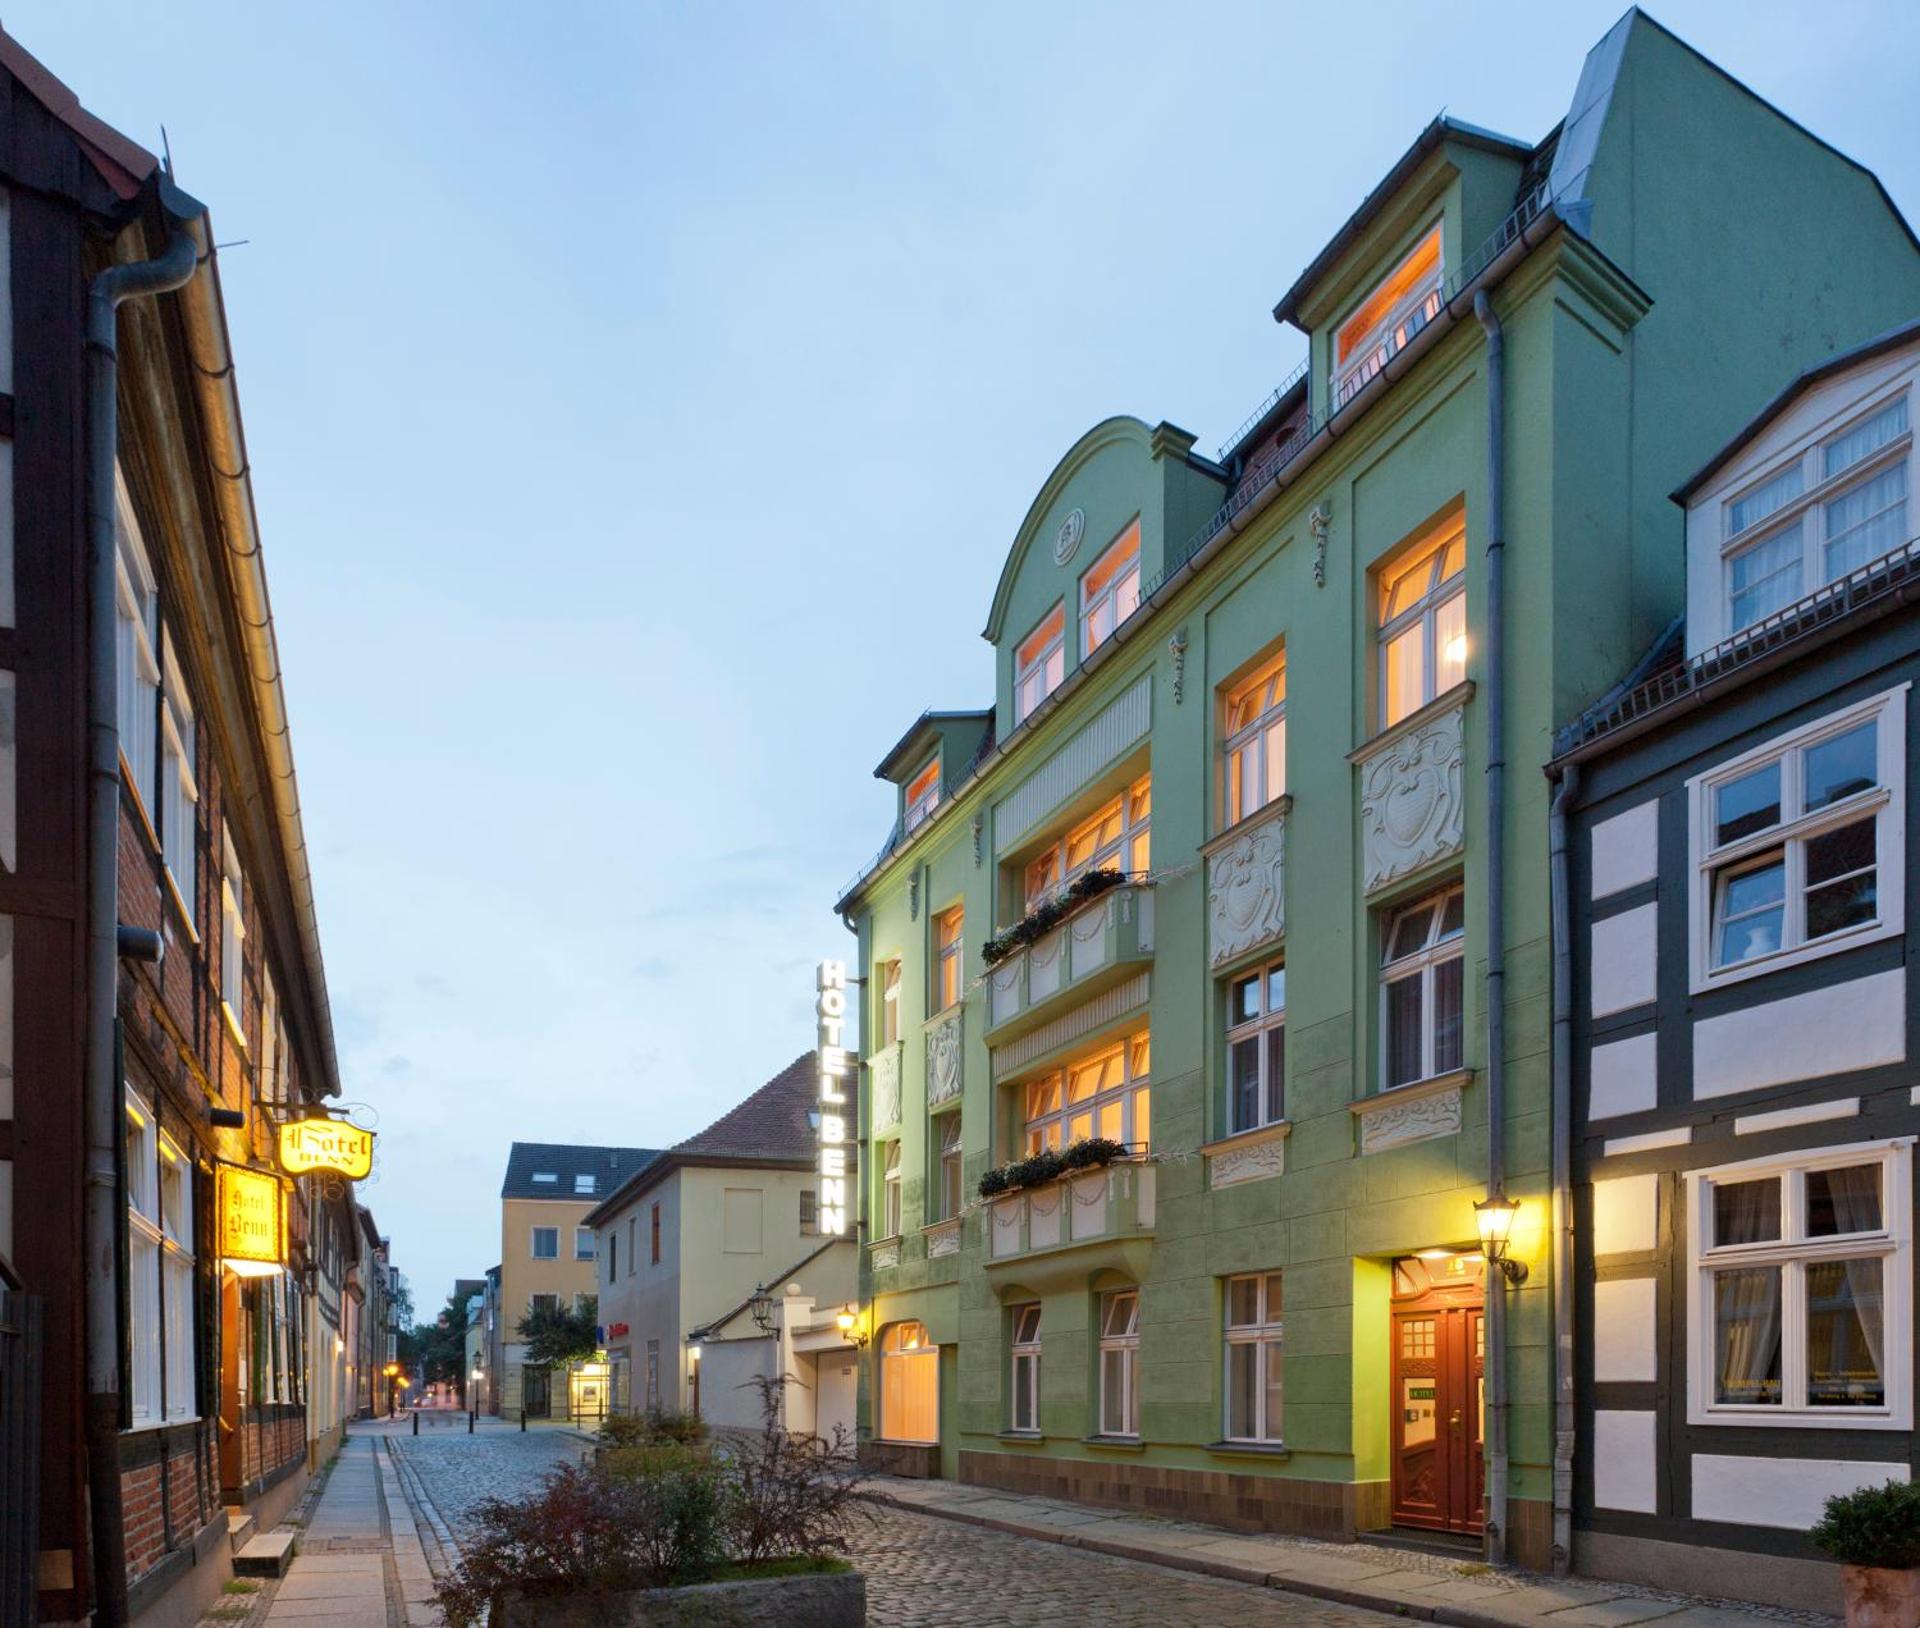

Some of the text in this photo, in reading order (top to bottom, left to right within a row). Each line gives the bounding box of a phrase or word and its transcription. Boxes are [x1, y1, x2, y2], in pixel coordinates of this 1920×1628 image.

[821, 959, 845, 1236] HOTEL BENN
[286, 1125, 367, 1156] Hotel
[299, 1152, 355, 1167] BENN
[231, 1189, 265, 1210] Hotel
[228, 1213, 269, 1239] Benn
